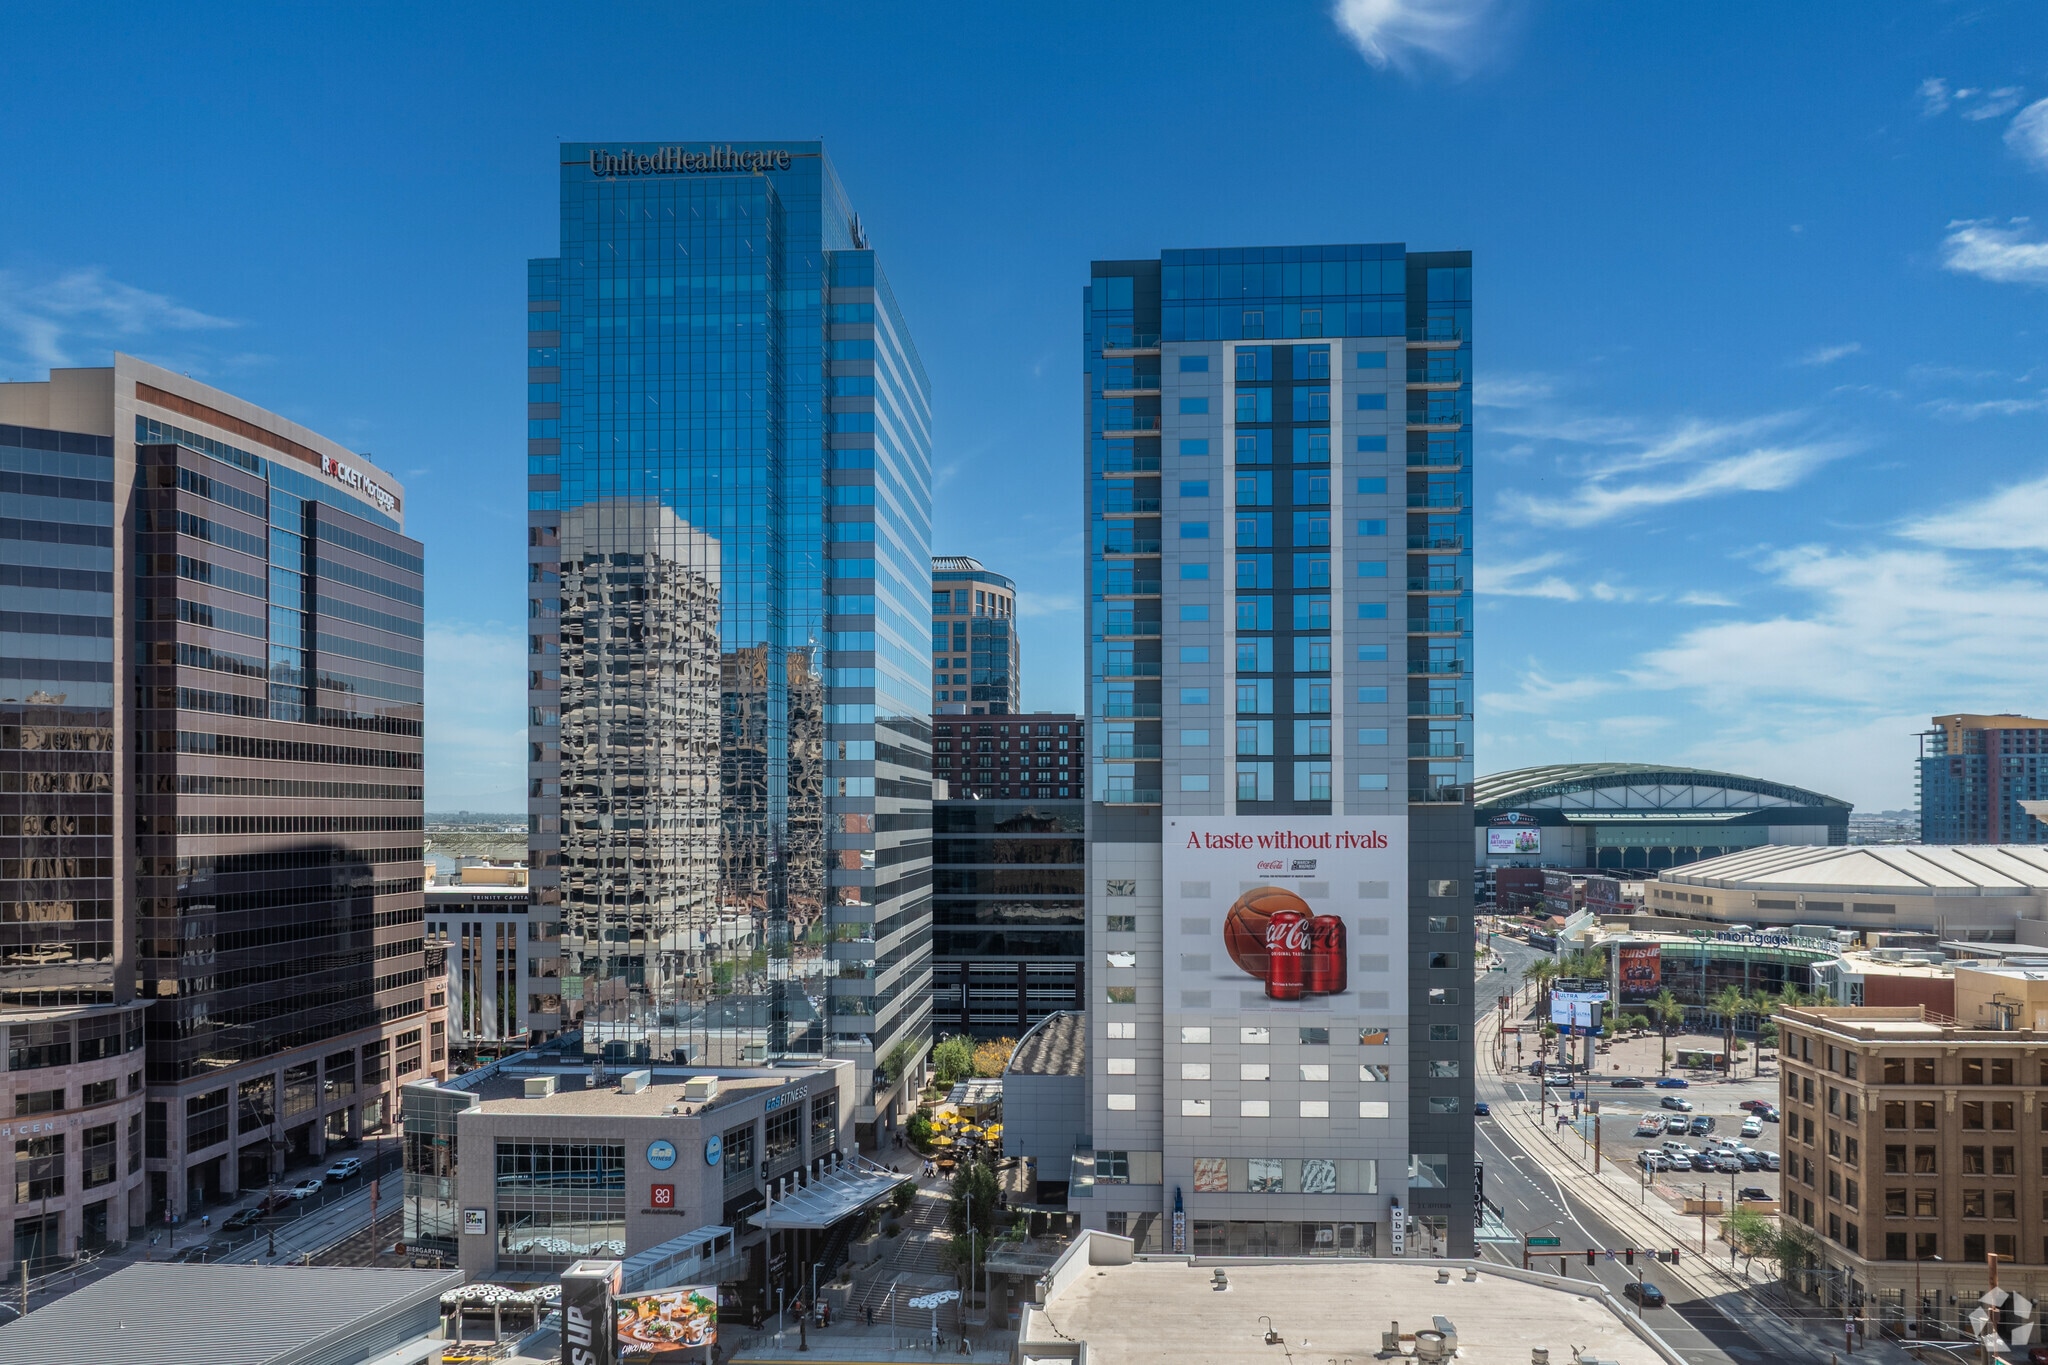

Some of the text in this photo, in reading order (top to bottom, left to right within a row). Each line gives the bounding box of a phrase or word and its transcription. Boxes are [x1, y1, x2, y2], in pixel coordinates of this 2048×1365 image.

[589, 144, 790, 174] UnitedHealthcare
[322, 454, 394, 510] ROCKET Mortgage
[1186, 830, 1388, 849] A taste without rivals
[1257, 860, 1283, 870] Coca-Cola
[1718, 931, 1789, 948] mortgage
[1647, 947, 1660, 957] UP
[780, 1085, 808, 1106] FITNESS
[1474, 1167, 1482, 1228] PALOMAR
[405, 1245, 444, 1256] BIERGARTEN
[621, 1344, 640, 1355] CHICO
